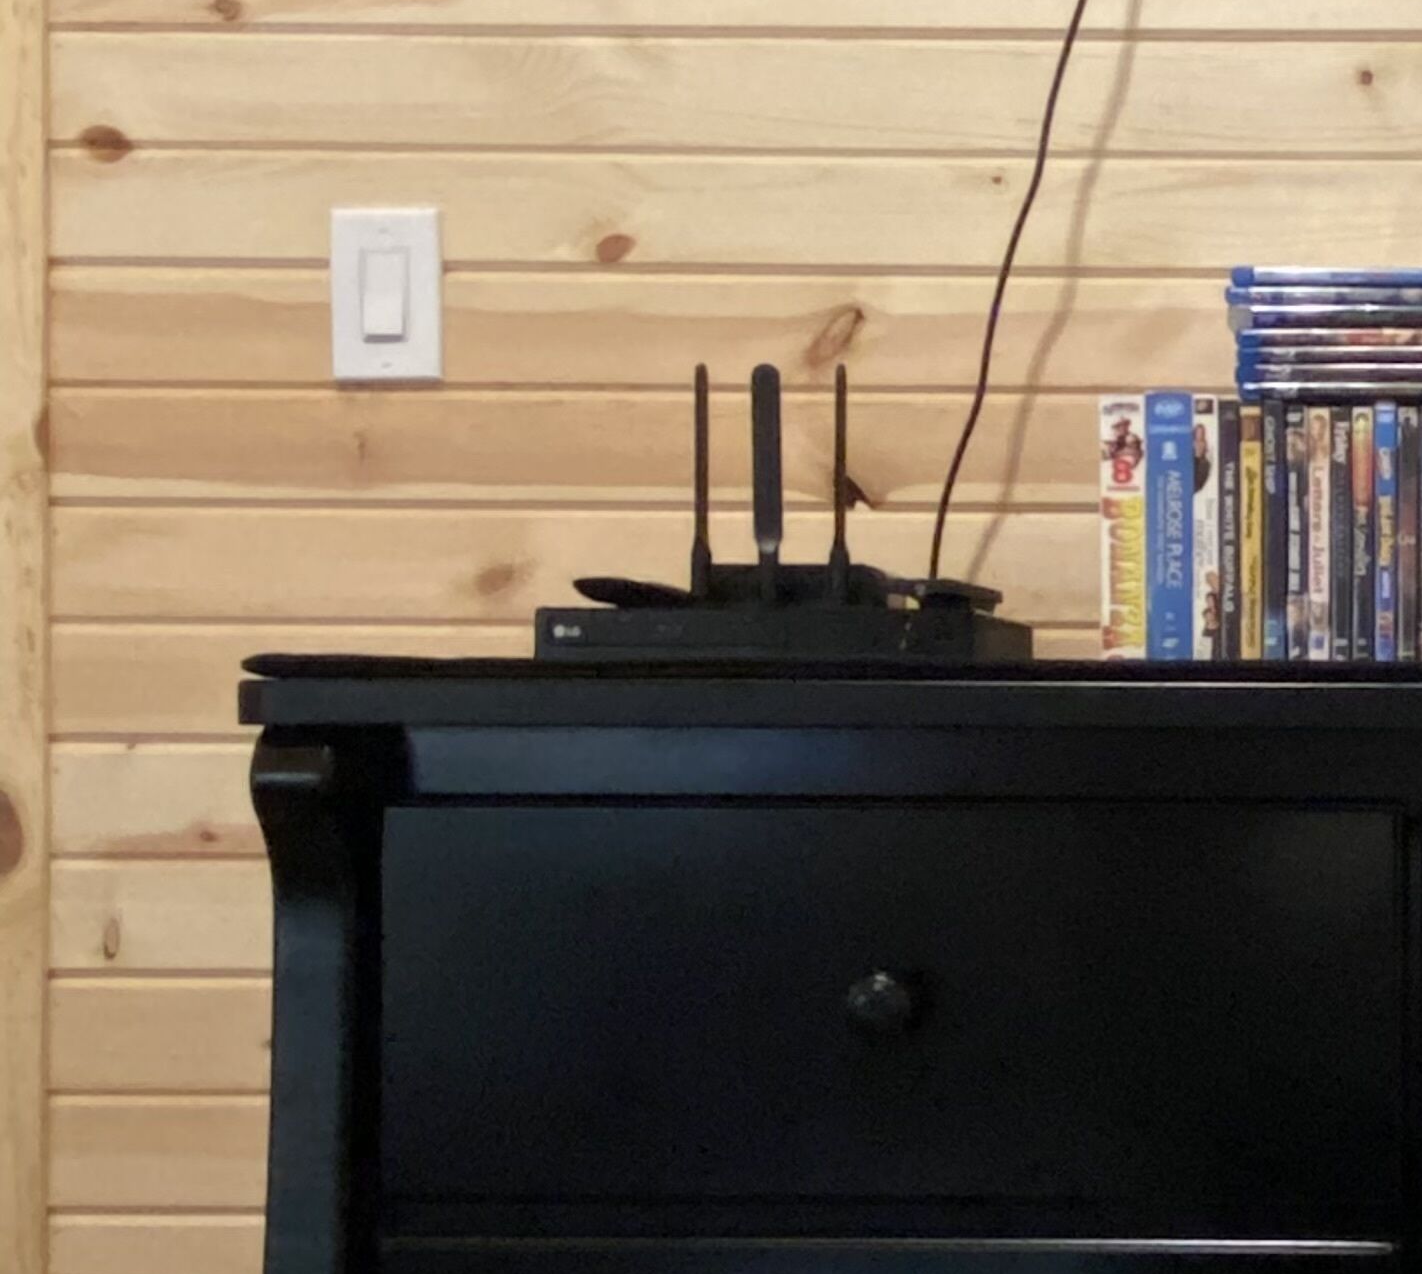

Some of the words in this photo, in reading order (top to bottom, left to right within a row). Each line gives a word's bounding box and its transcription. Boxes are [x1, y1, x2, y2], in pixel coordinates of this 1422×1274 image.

[1223, 461, 1236, 489] THE
[1165, 470, 1183, 538] MELROSE
[1101, 496, 1145, 650] BONANZA
[1166, 542, 1183, 589] PLACE
